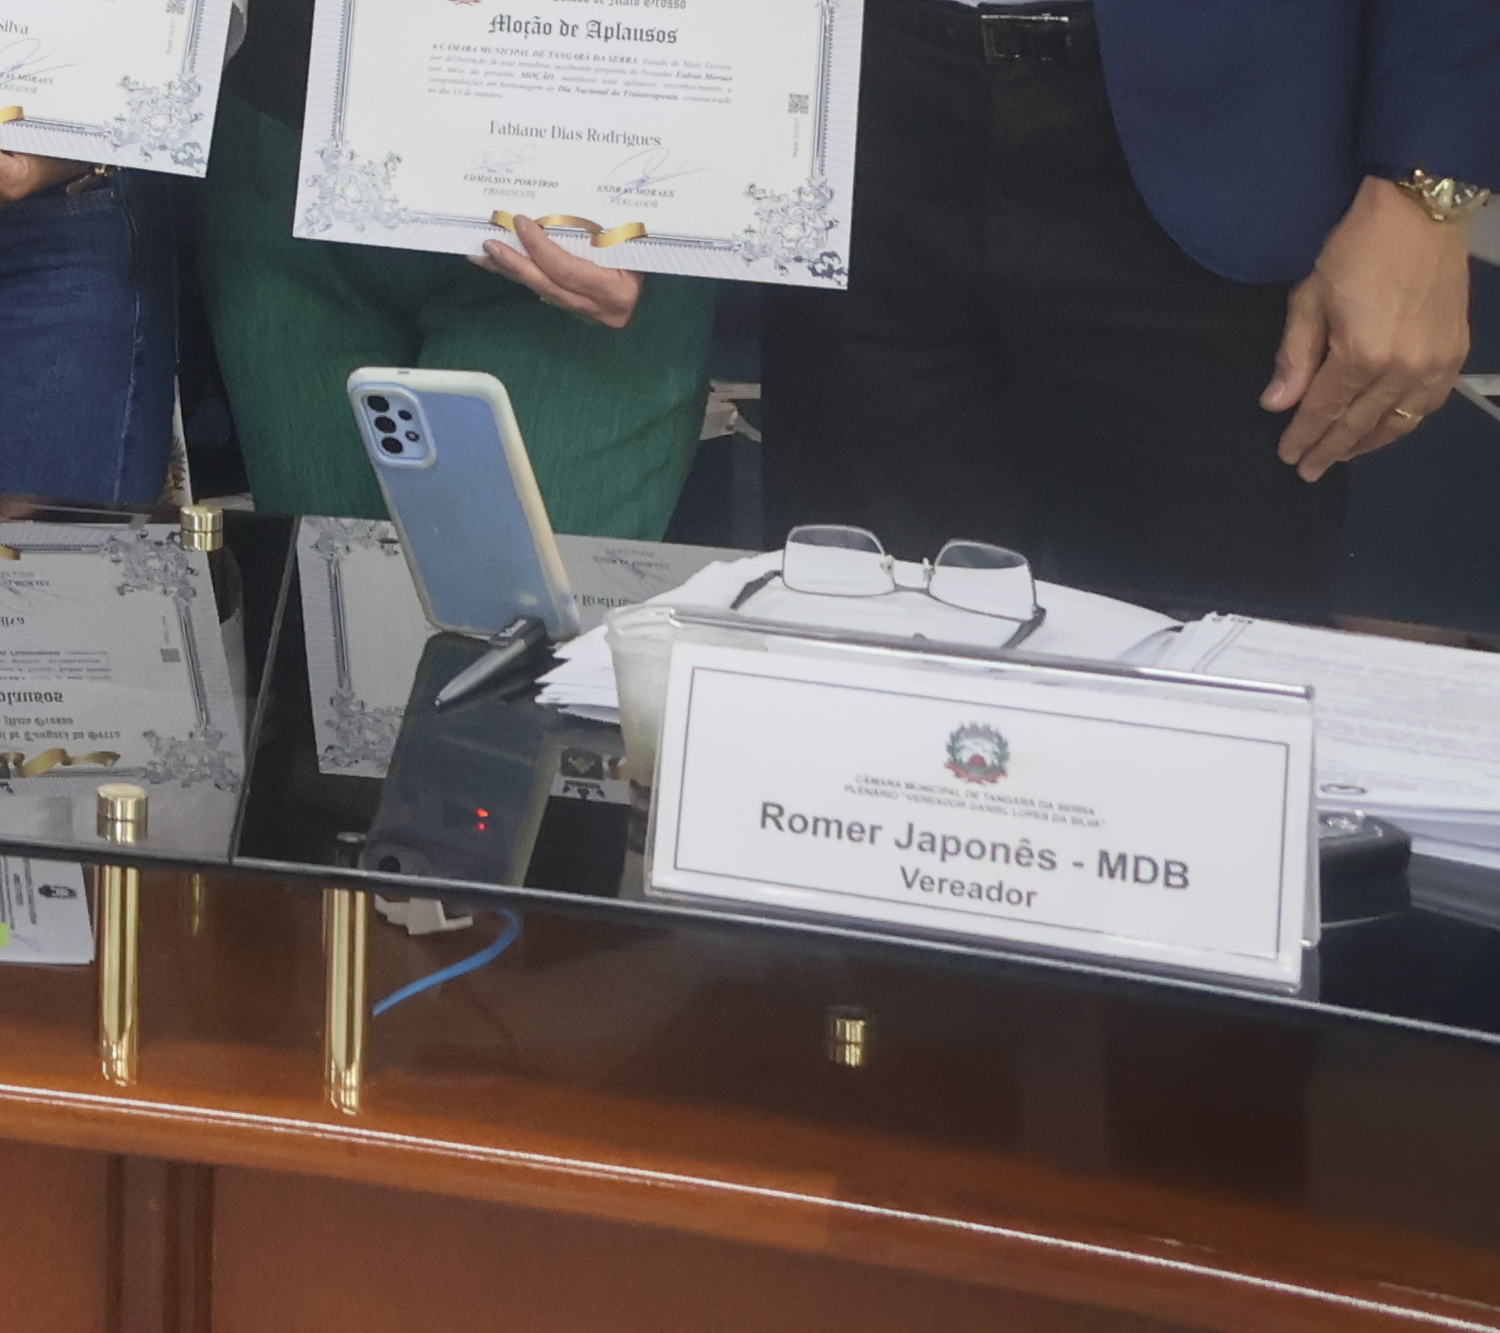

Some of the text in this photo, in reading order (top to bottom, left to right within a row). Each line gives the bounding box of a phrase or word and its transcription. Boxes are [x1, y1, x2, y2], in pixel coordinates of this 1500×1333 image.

[488, 14, 677, 44] Moção de Aplausos
[490, 121, 660, 147] Fabiane Dias Rodrigues
[760, 800, 1190, 891] Romer Japonês - MDB
[900, 866, 1037, 908] Vereador
